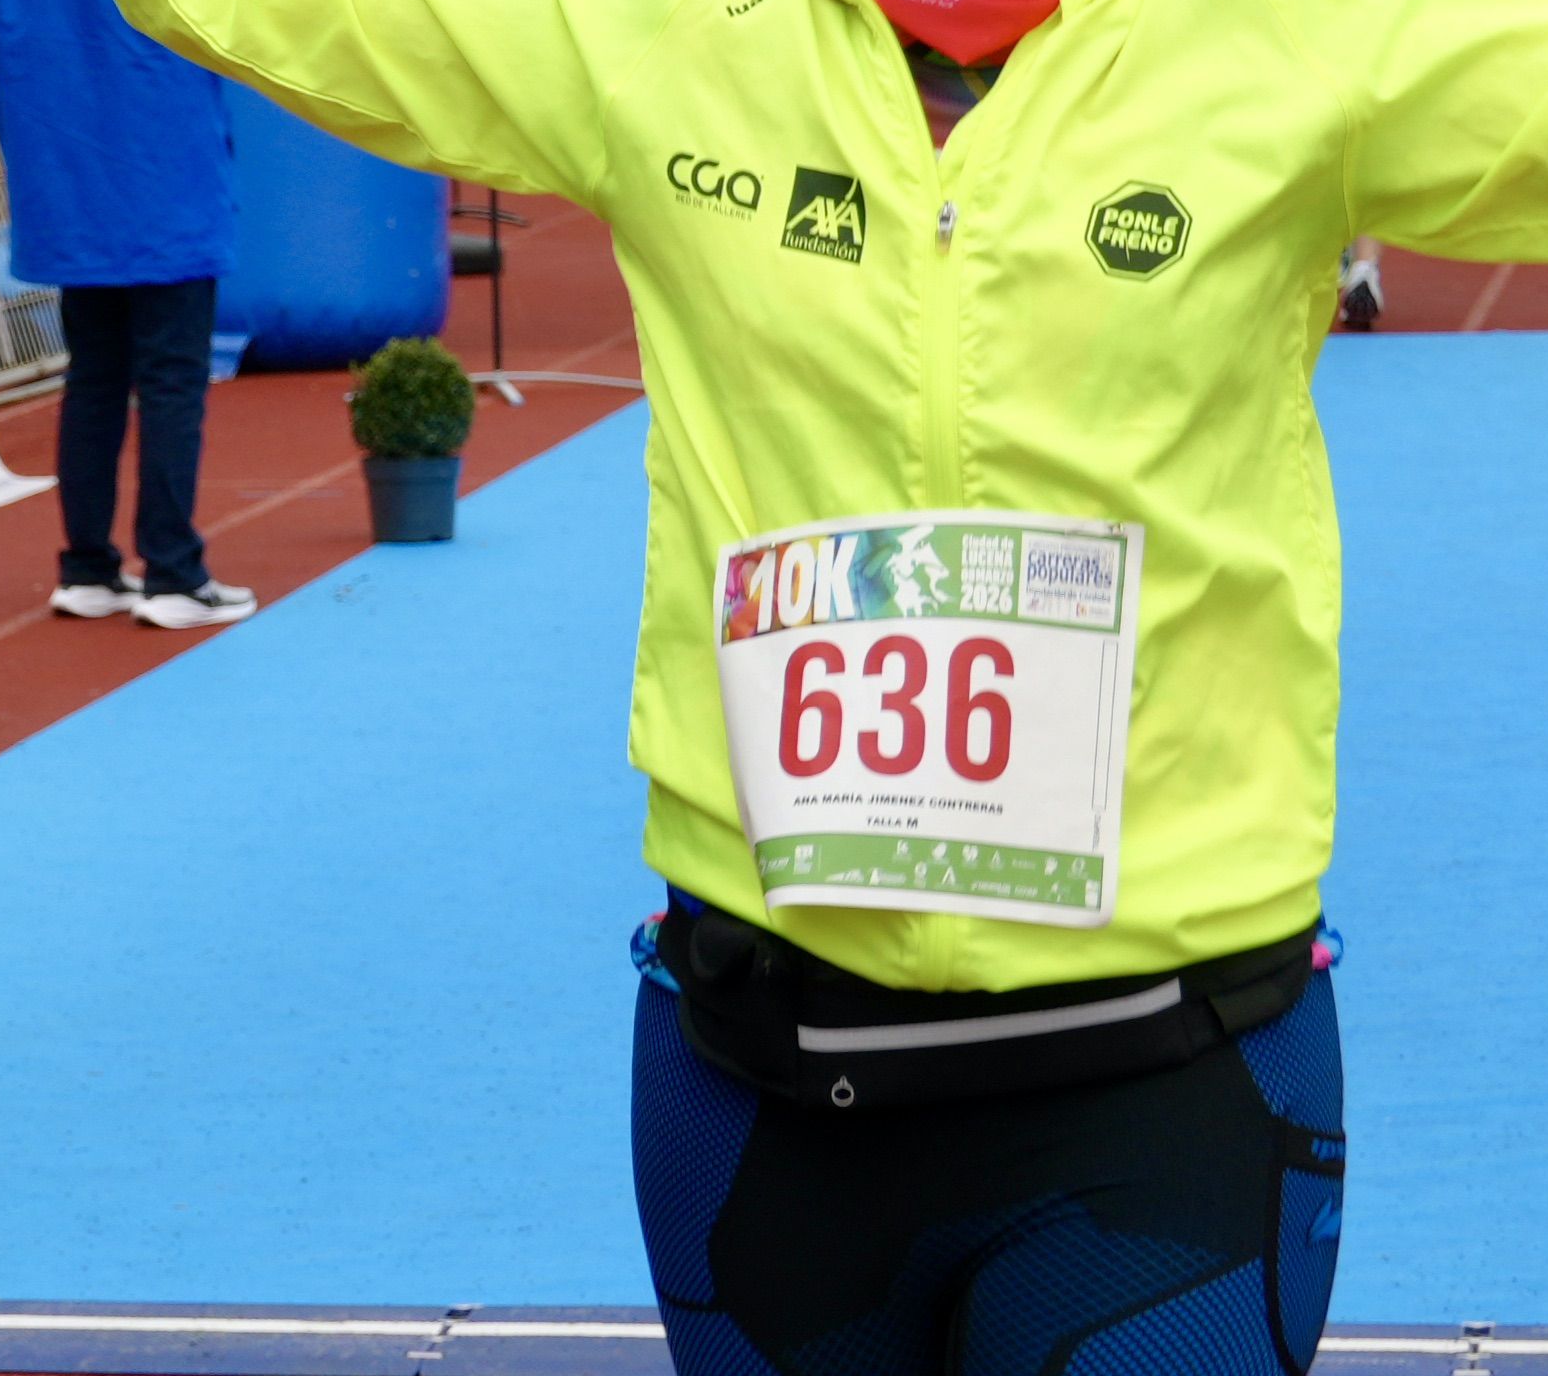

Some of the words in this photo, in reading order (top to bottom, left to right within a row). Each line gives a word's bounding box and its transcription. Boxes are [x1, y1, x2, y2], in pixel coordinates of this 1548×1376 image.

[707, 201, 753, 222] TALLERES
[786, 195, 863, 245] AXA
[1102, 207, 1179, 237] PONLE
[785, 230, 859, 262] fundación
[1097, 225, 1174, 256] FRENO
[749, 535, 858, 633] 10K
[960, 583, 1014, 615] 2026
[778, 634, 1016, 783] 636
[793, 795, 819, 807] ANA
[822, 792, 864, 806] MARÍA
[929, 798, 1004, 815] CONTRERAS
[866, 815, 903, 829] TALLA
[906, 817, 919, 830] M
